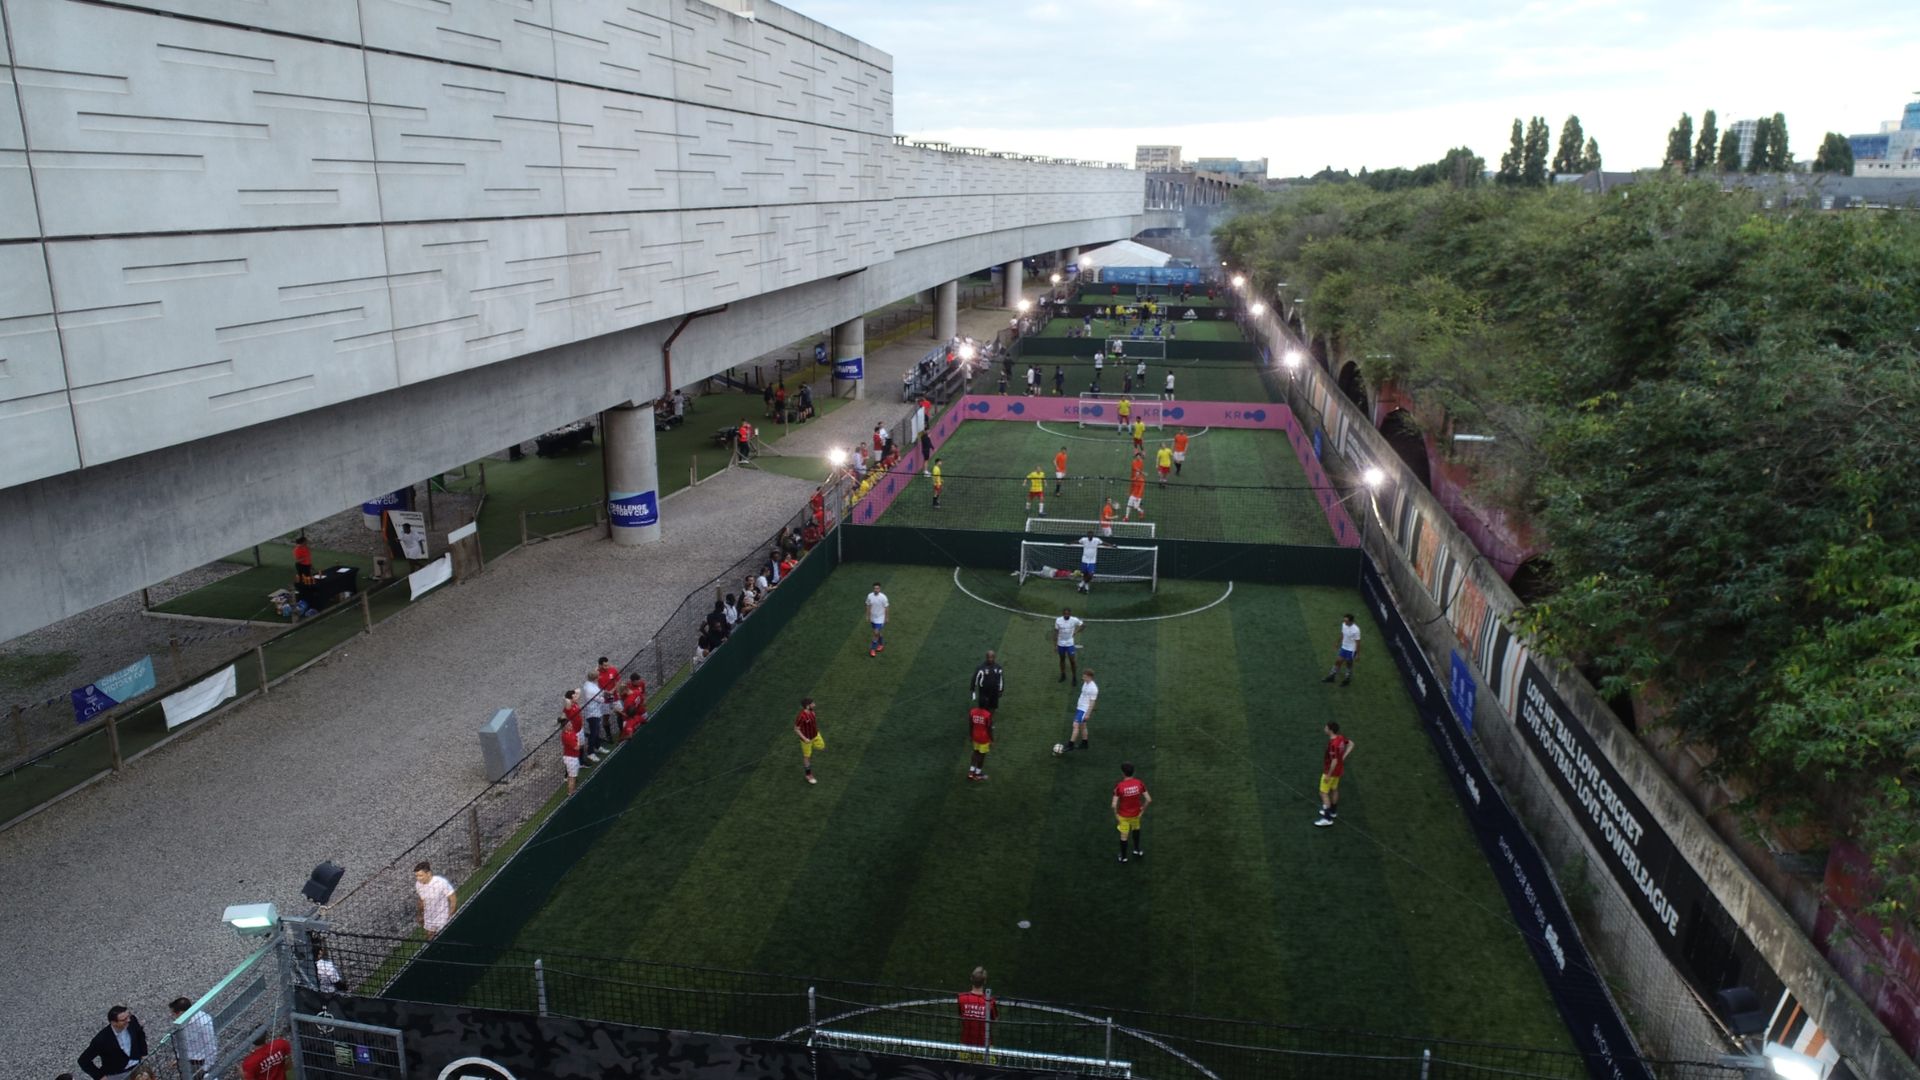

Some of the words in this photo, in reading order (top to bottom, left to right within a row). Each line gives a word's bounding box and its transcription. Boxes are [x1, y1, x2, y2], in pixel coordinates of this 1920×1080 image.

[1523, 699, 1541, 735] LOVE
[1540, 725, 1577, 790] FOOTBALL
[1577, 778, 1601, 824] LOVE
[1600, 811, 1679, 936] POWERLEAGUE
[1526, 677, 1545, 714] LOVE
[1543, 702, 1576, 759] NETBALL
[1576, 746, 1600, 790] LOVE
[1599, 779, 1643, 847] CRICKET
